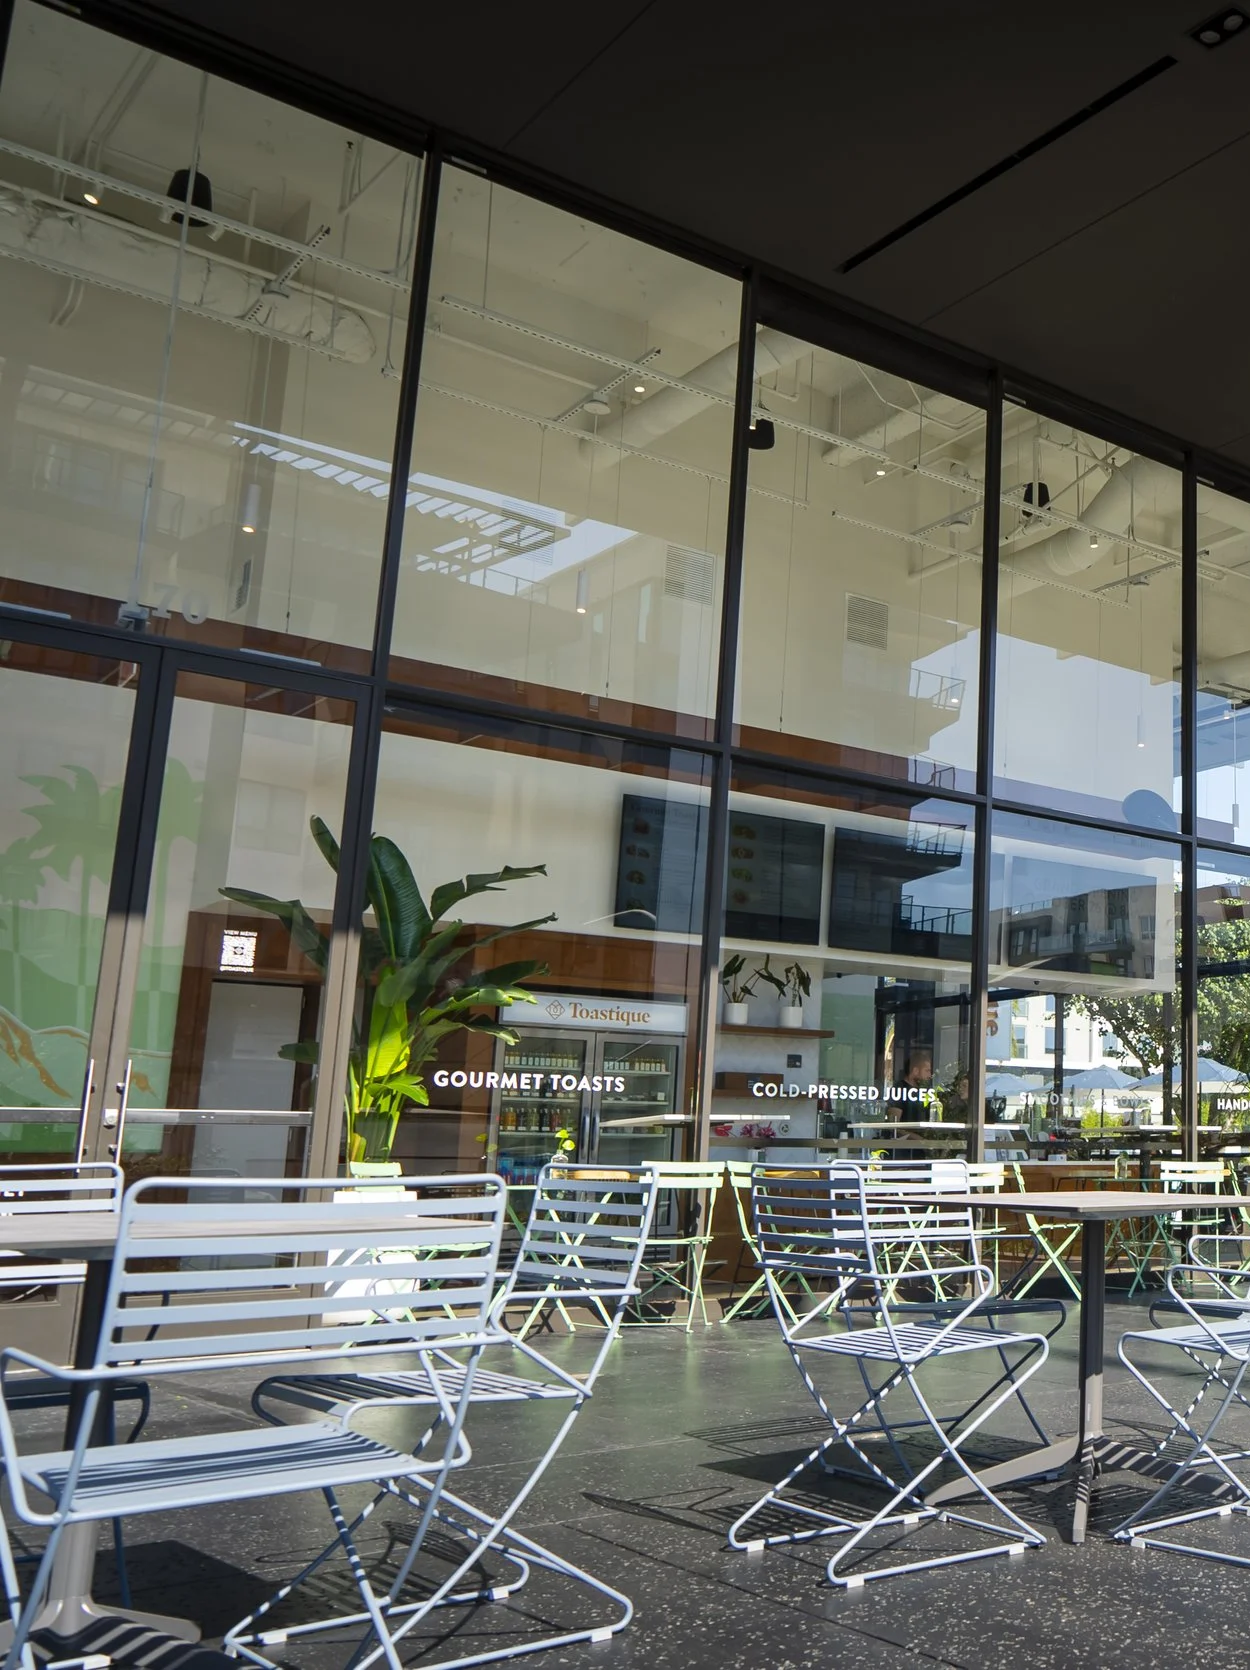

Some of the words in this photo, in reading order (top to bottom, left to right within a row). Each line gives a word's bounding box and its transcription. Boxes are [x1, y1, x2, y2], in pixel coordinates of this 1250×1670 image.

[568, 1002, 651, 1026] Toastique
[433, 1069, 545, 1090] GOURMET
[549, 1074, 625, 1093] TOASTS
[752, 1082, 879, 1100] COLD-PRESSED
[883, 1086, 936, 1102] JUICES
